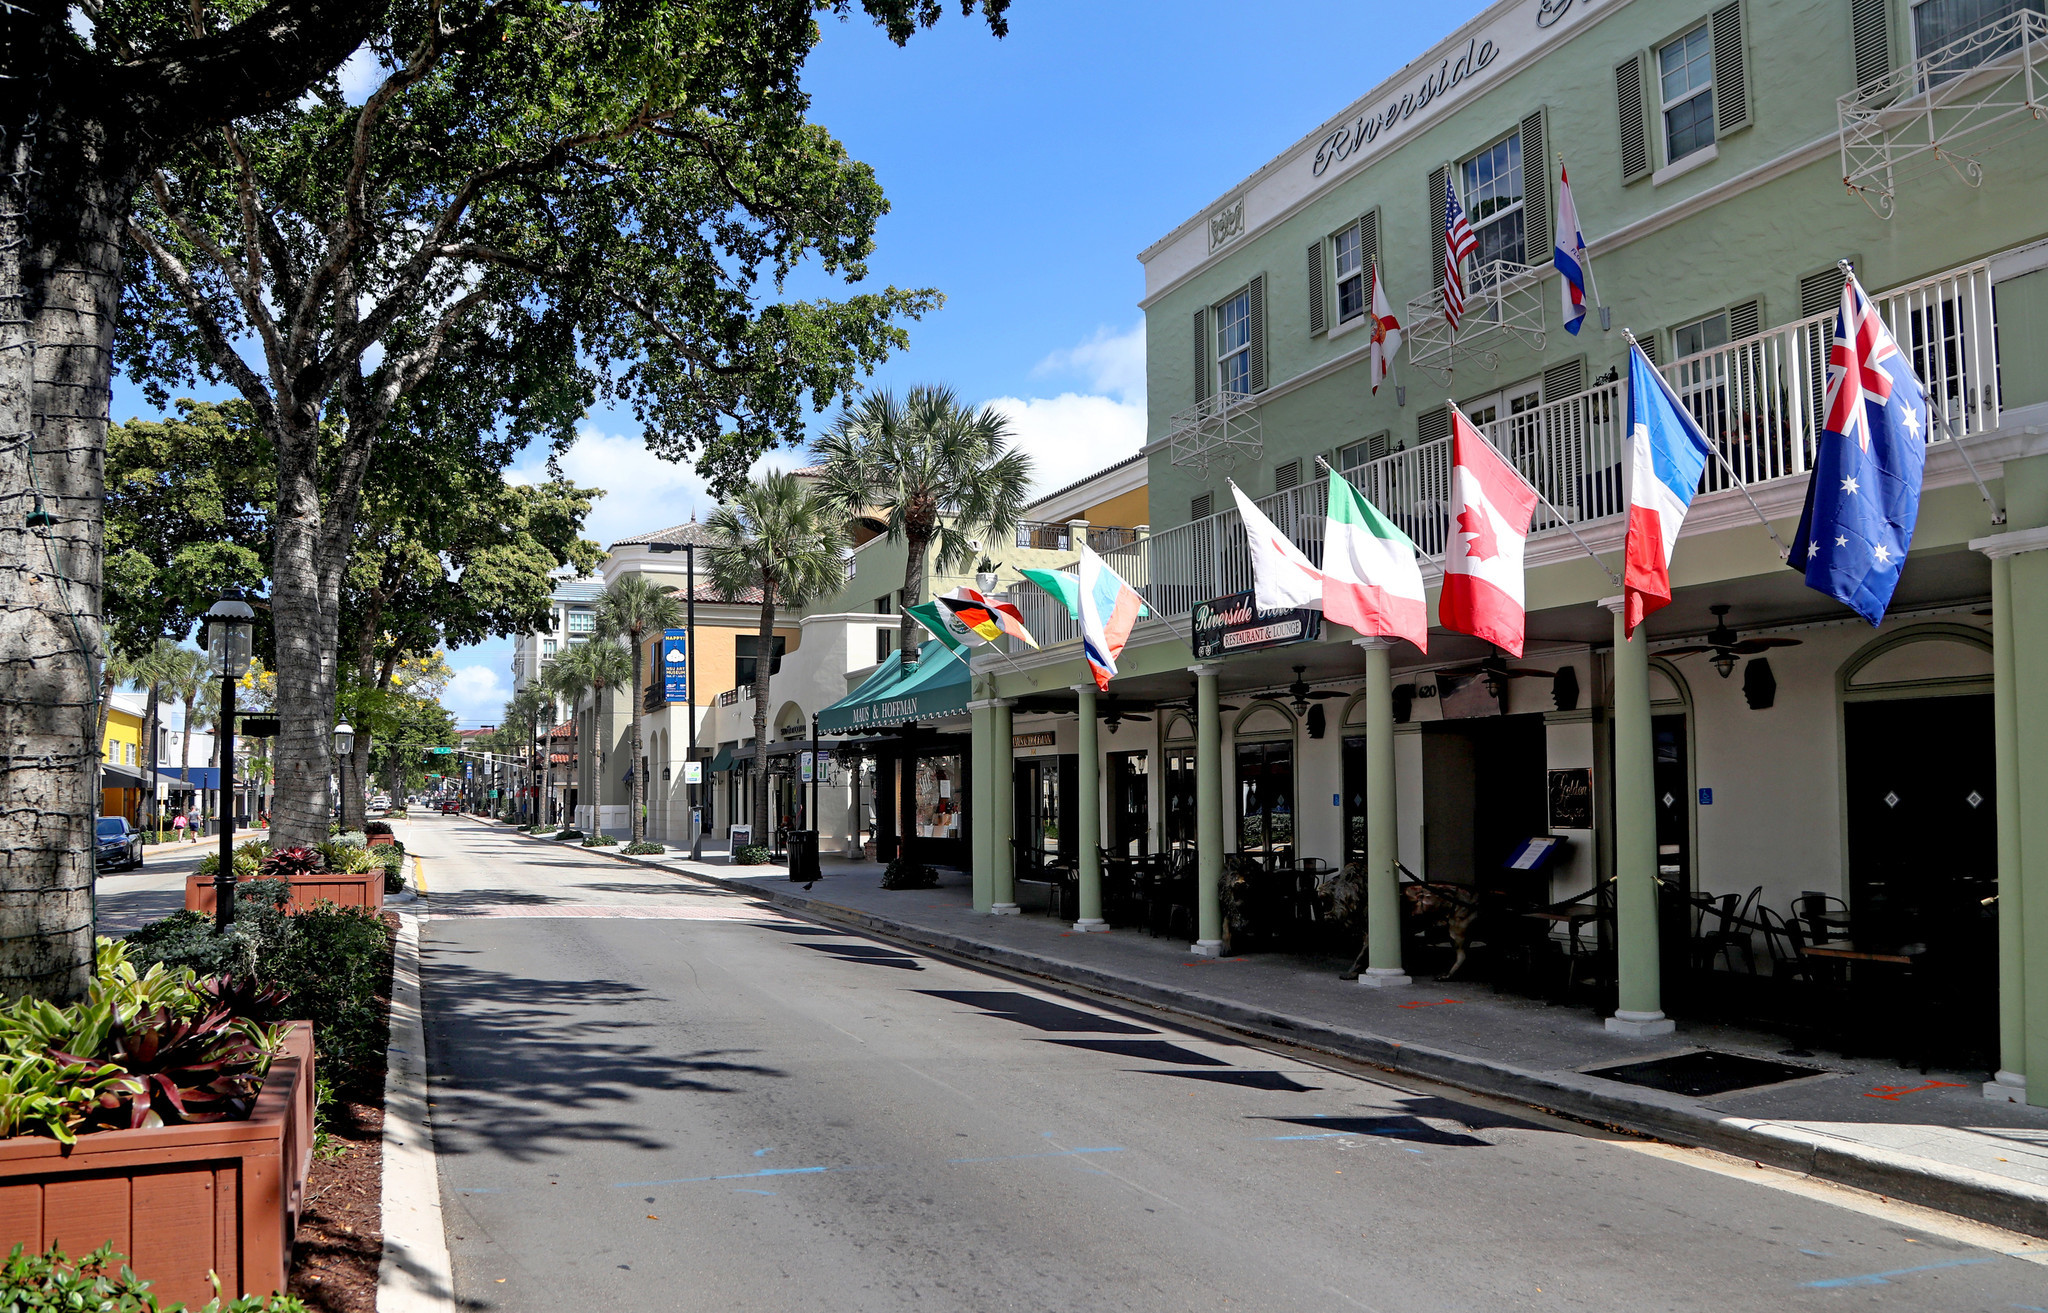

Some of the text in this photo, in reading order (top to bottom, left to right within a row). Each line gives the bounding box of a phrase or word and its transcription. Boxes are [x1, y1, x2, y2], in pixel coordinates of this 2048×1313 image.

[1312, 38, 1500, 177] Riverside
[1195, 595, 1253, 632] Riverside
[1225, 621, 1300, 647] RESTAURANT & LOUNGE
[1419, 685, 1437, 698] 620
[853, 697, 918, 723] MAUS & HOFFMAN
